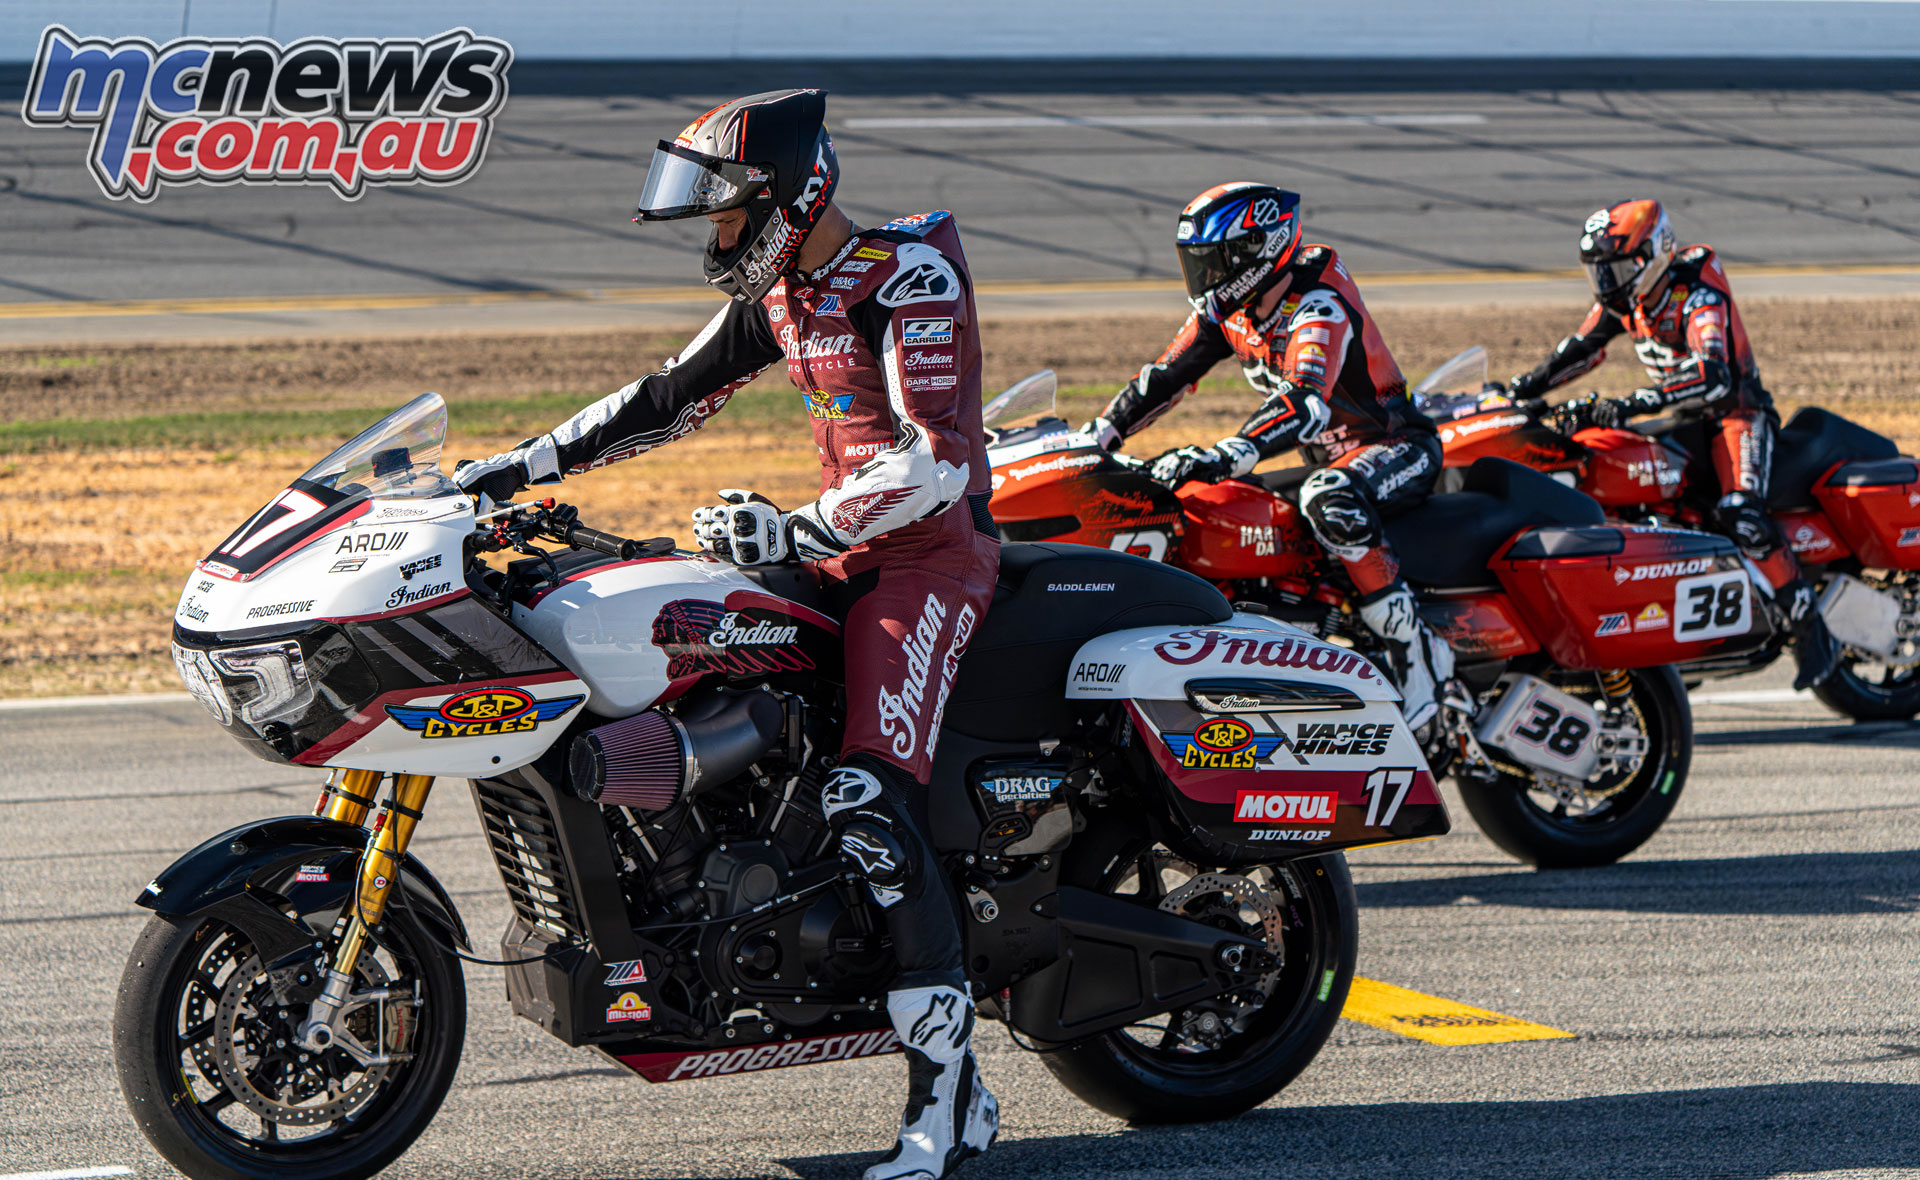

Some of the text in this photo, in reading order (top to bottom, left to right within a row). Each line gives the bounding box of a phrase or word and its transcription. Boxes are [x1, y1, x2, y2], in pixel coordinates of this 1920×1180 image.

[746, 221, 792, 284] Indian
[1268, 229, 1288, 255] SHOEI
[832, 276, 855, 286] DRAG
[1233, 261, 1274, 300] DAVIDSON
[780, 324, 855, 360] Indian
[905, 336, 951, 344] CARRILLO
[904, 351, 953, 366] Indian
[906, 378, 931, 386] DARK
[855, 493, 883, 517] Indian
[219, 488, 327, 558] 17
[399, 554, 443, 571] VANCE
[1630, 558, 1713, 581] DUNLOP
[386, 582, 451, 608] Indian
[1047, 583, 1115, 592] SADDLEMEN
[246, 600, 316, 619] PROGRESSIVE
[1680, 580, 1744, 633] 38
[709, 612, 797, 648] Indian
[1154, 629, 1376, 681] Indian
[878, 593, 946, 760] Indian
[456, 693, 524, 722] J&P
[1220, 697, 1259, 709] Indian
[425, 711, 538, 738] CYCLES
[1200, 723, 1247, 746] J&P
[1296, 724, 1395, 740] VANCE
[1515, 699, 1590, 755] 38
[1184, 744, 1258, 768] CYCLES
[1292, 739, 1387, 755] HINES
[994, 777, 1050, 793] DRAG
[996, 793, 1051, 803] Specialties
[1237, 794, 1331, 819] MOTUL
[1364, 770, 1416, 827] 17
[1248, 829, 1331, 841] DUNLOP
[667, 1030, 901, 1080] PROGRESSIVE
